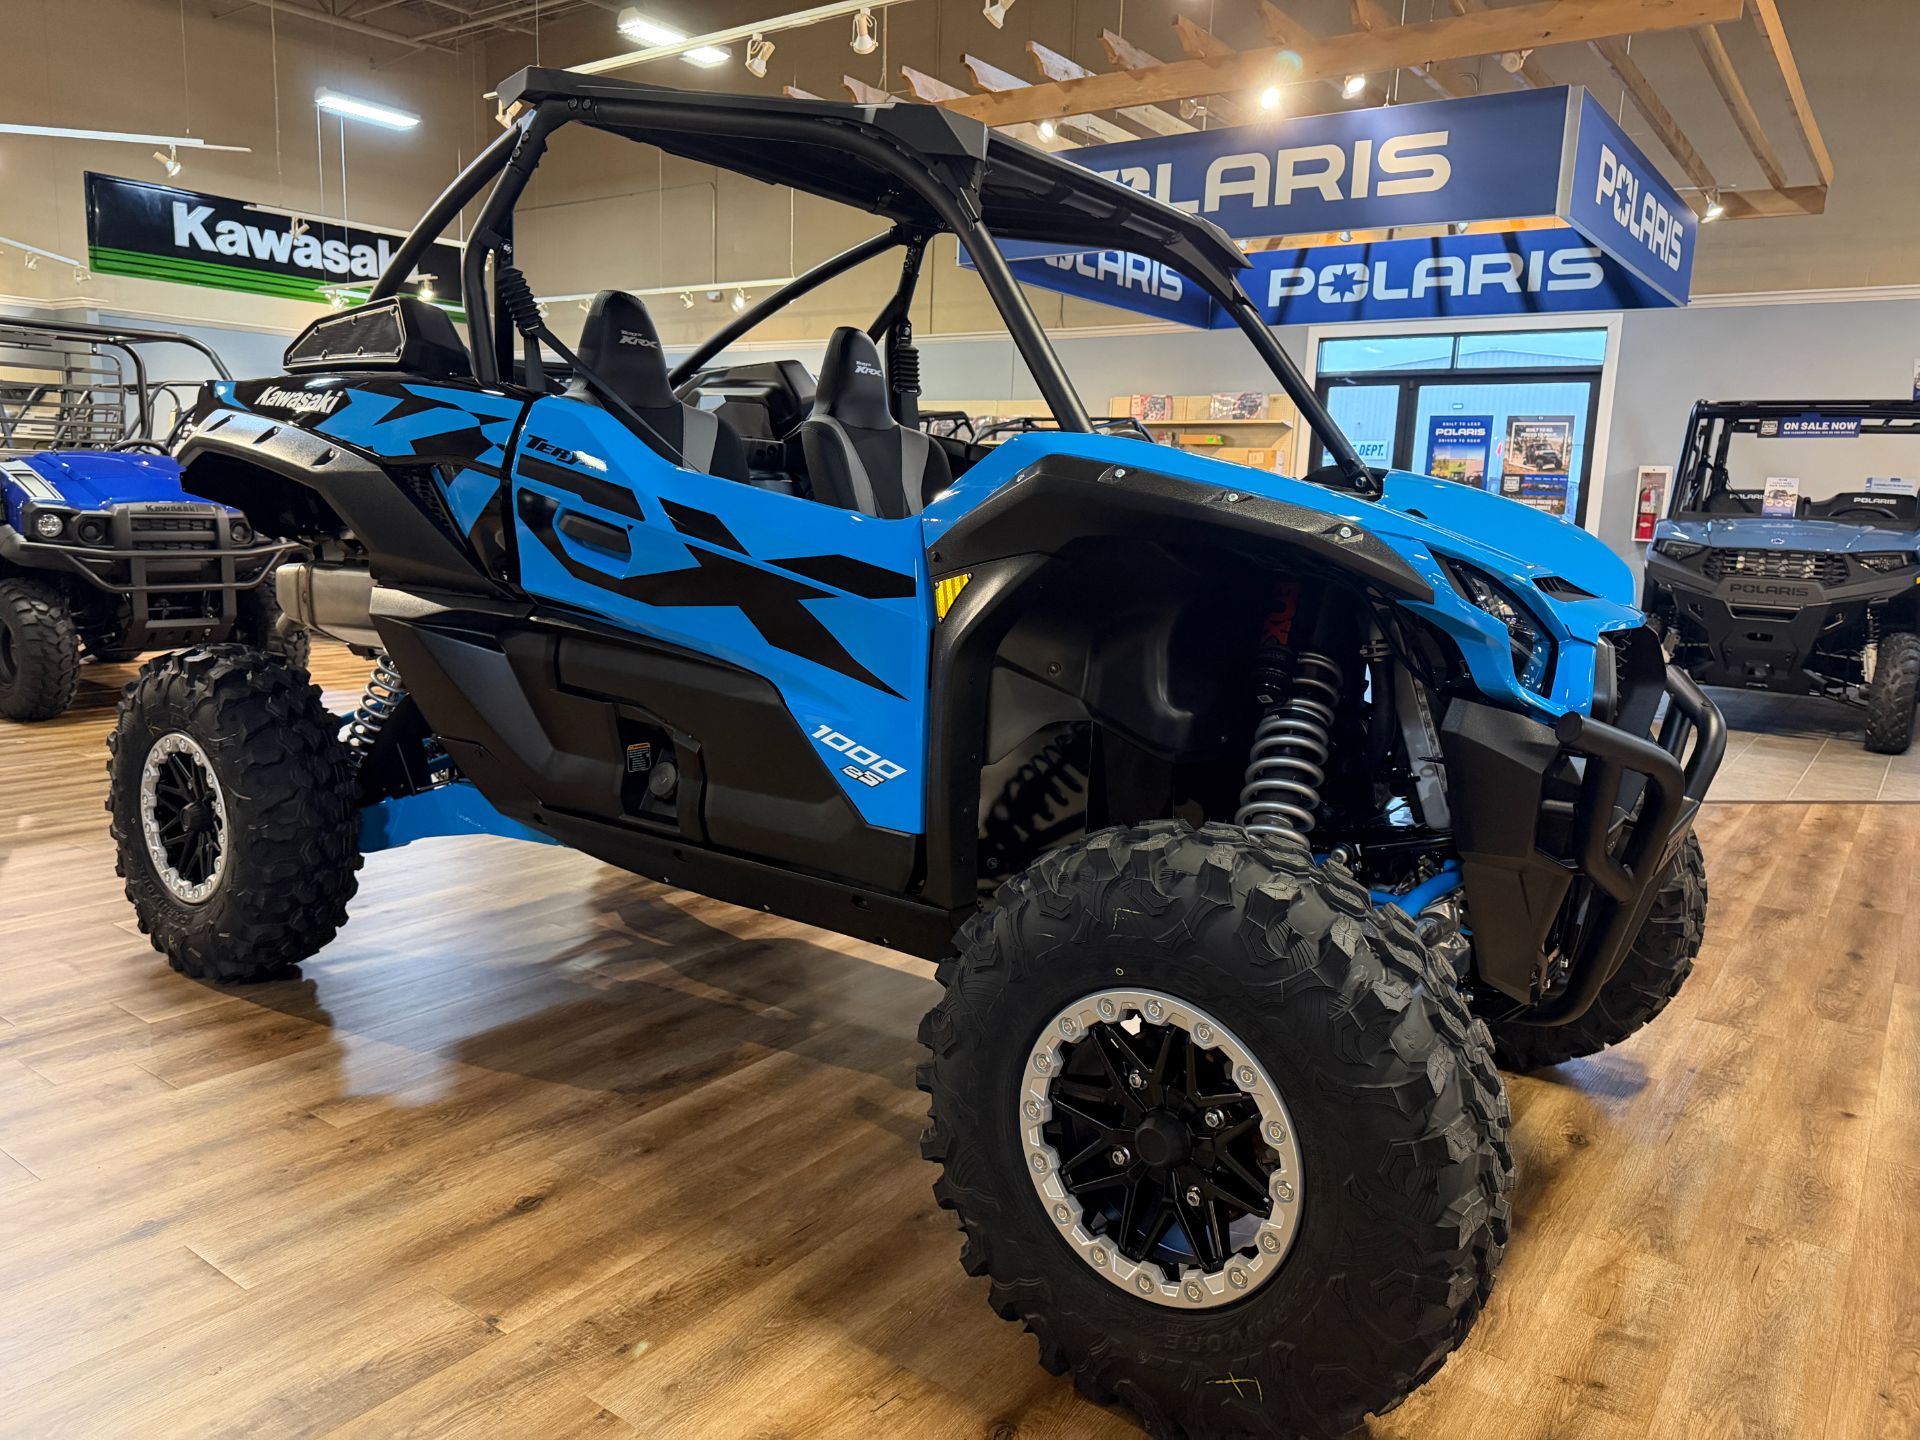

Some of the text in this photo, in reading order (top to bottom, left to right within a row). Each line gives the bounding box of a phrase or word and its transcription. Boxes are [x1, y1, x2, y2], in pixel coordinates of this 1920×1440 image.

[1595, 144, 1684, 272] POLARIS
[1267, 247, 1604, 307] POLARIS
[619, 335, 658, 349] KRX
[854, 365, 882, 377] KRX
[254, 386, 344, 414] Kawasaki
[1435, 428, 1486, 436] POLARIS
[1783, 422, 1799, 431] ON
[1800, 422, 1829, 431] SALE
[1828, 422, 1857, 431] NOW
[1359, 444, 1384, 456] DEPT.
[1853, 497, 1897, 505] POLARIS
[1729, 583, 1809, 597] POLARIS
[811, 724, 908, 780] 1000
